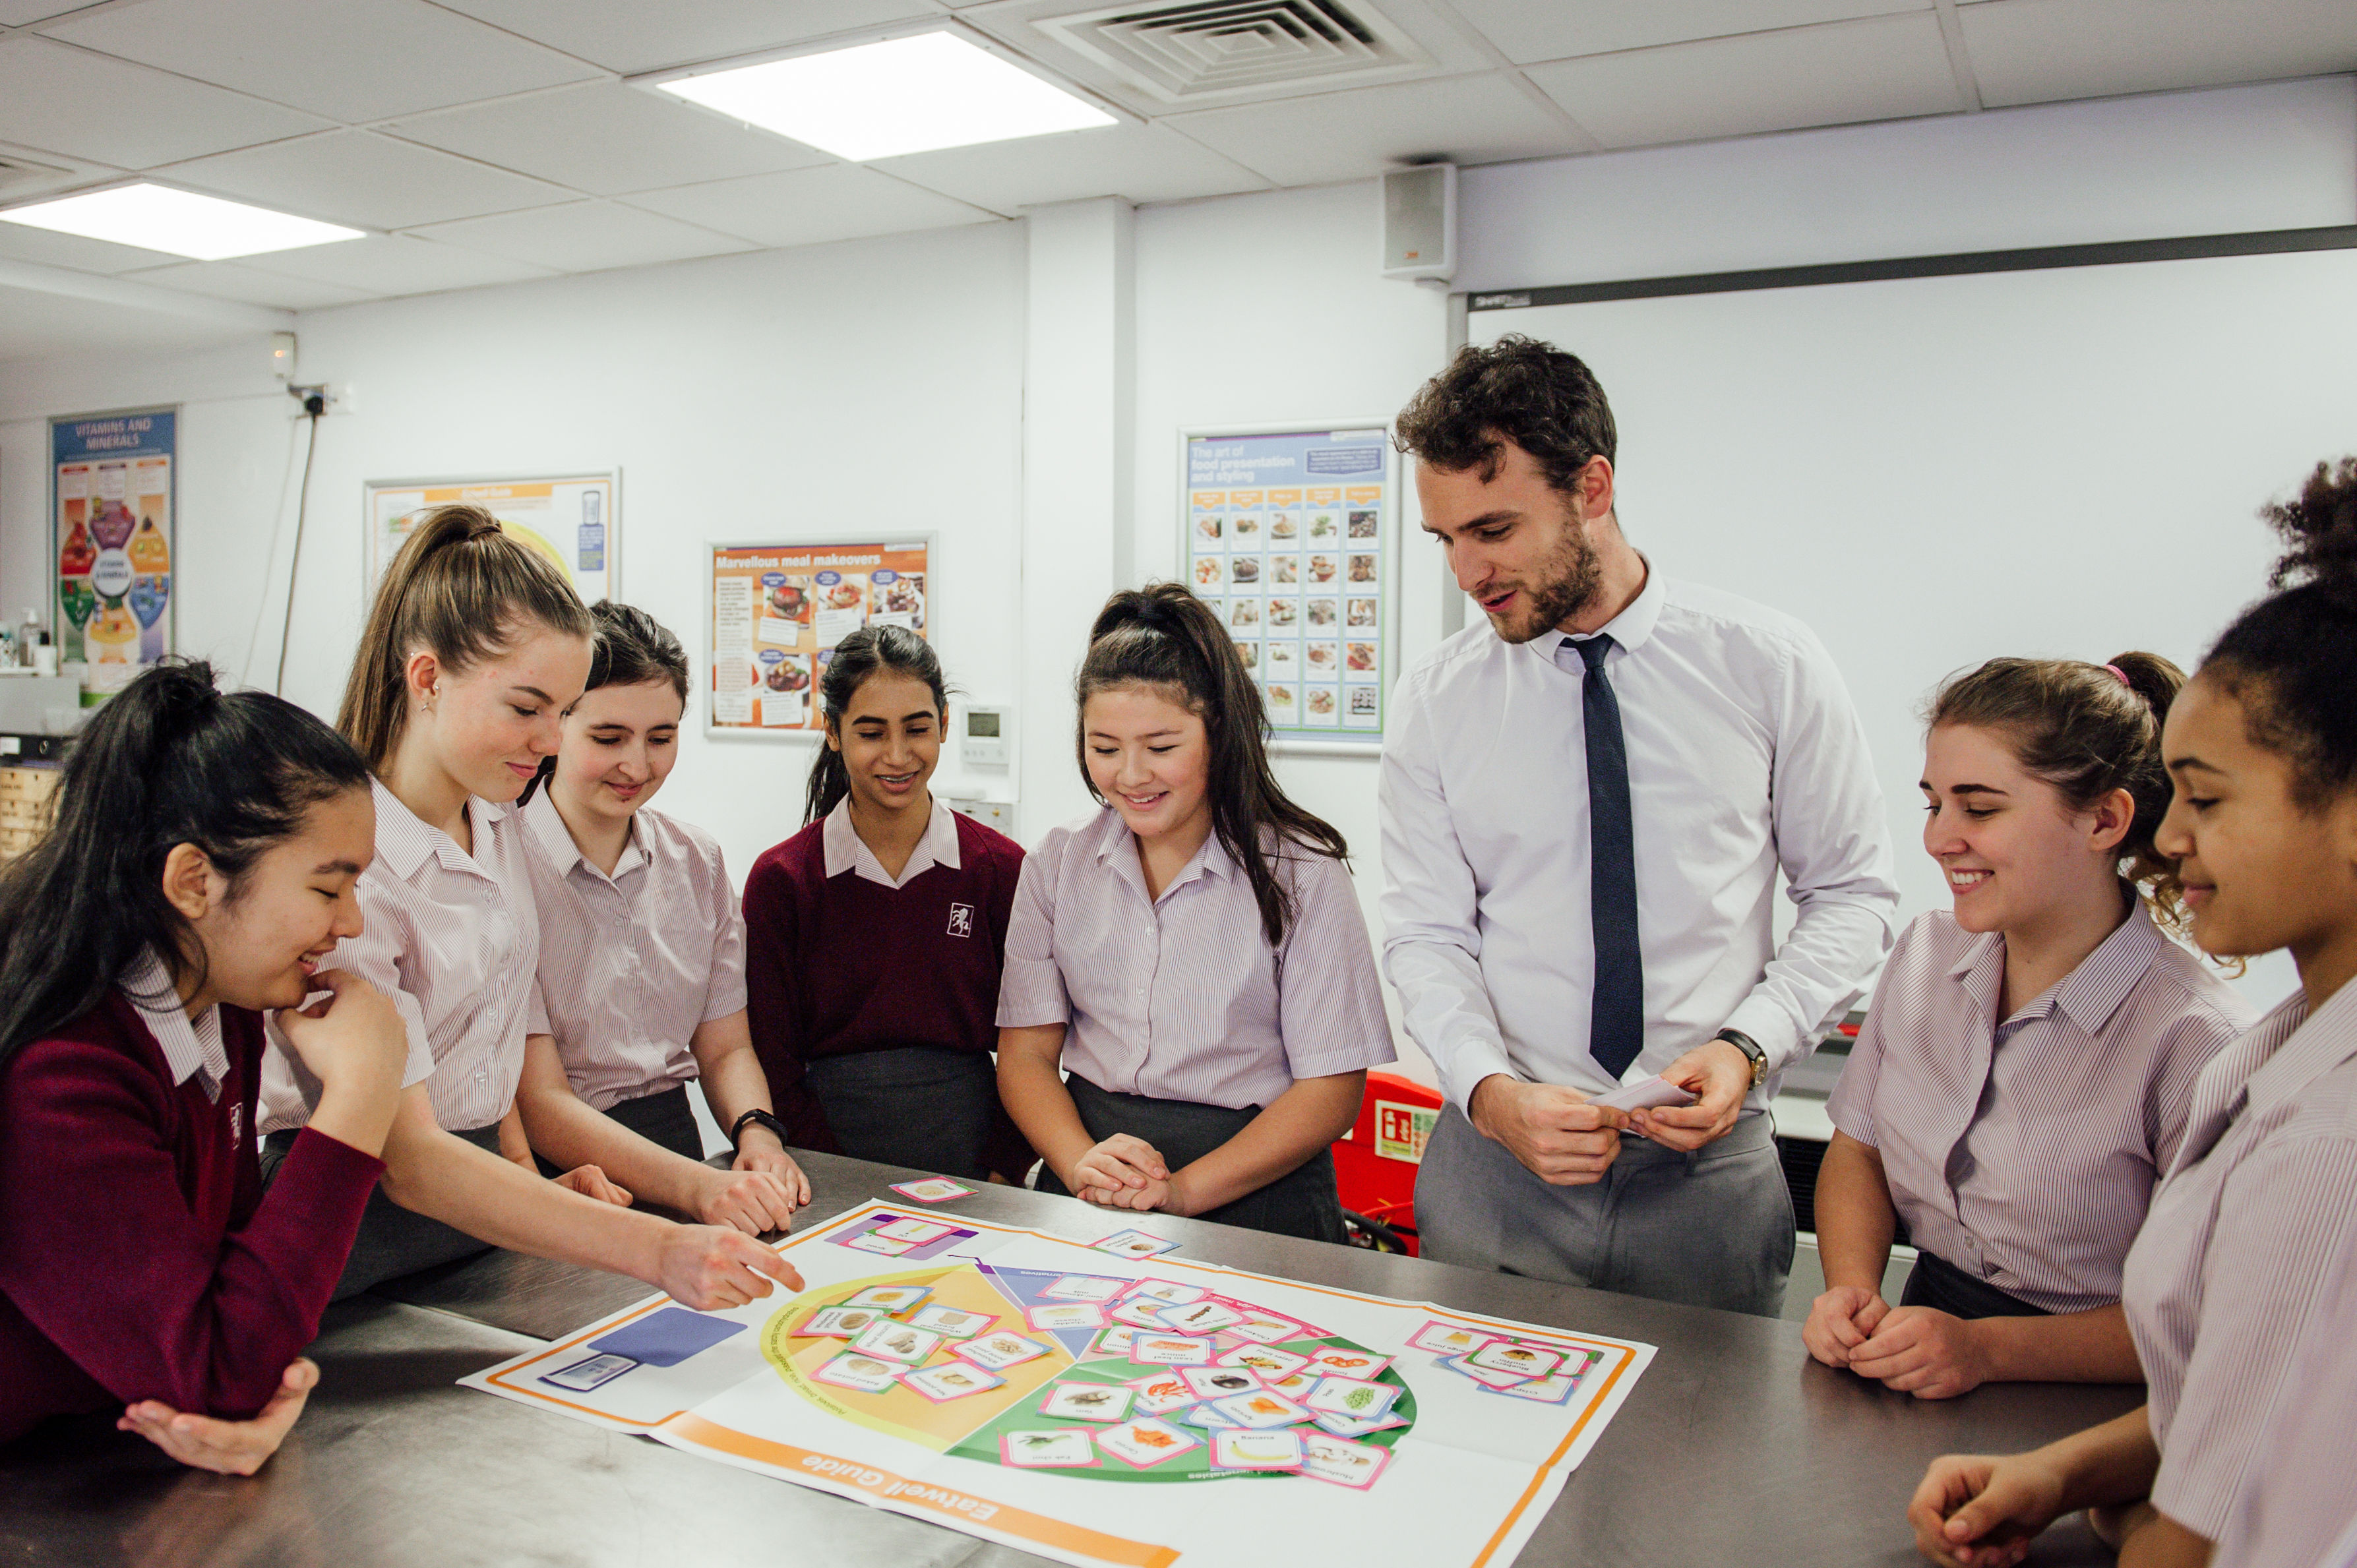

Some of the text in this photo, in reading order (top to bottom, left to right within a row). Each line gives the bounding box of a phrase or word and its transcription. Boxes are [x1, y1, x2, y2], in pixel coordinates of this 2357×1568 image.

[76, 417, 152, 437] VITAMINS AND
[86, 433, 139, 450] MINERALS
[1192, 444, 1244, 458] The art of
[1191, 458, 1218, 471] food
[1221, 456, 1295, 471] presentation
[1191, 470, 1254, 484] and styling
[716, 553, 881, 568] Marvellous meal makeovers
[1490, 1360, 1529, 1371] Blueberry
[802, 1455, 999, 1521] Eatwell Guide
